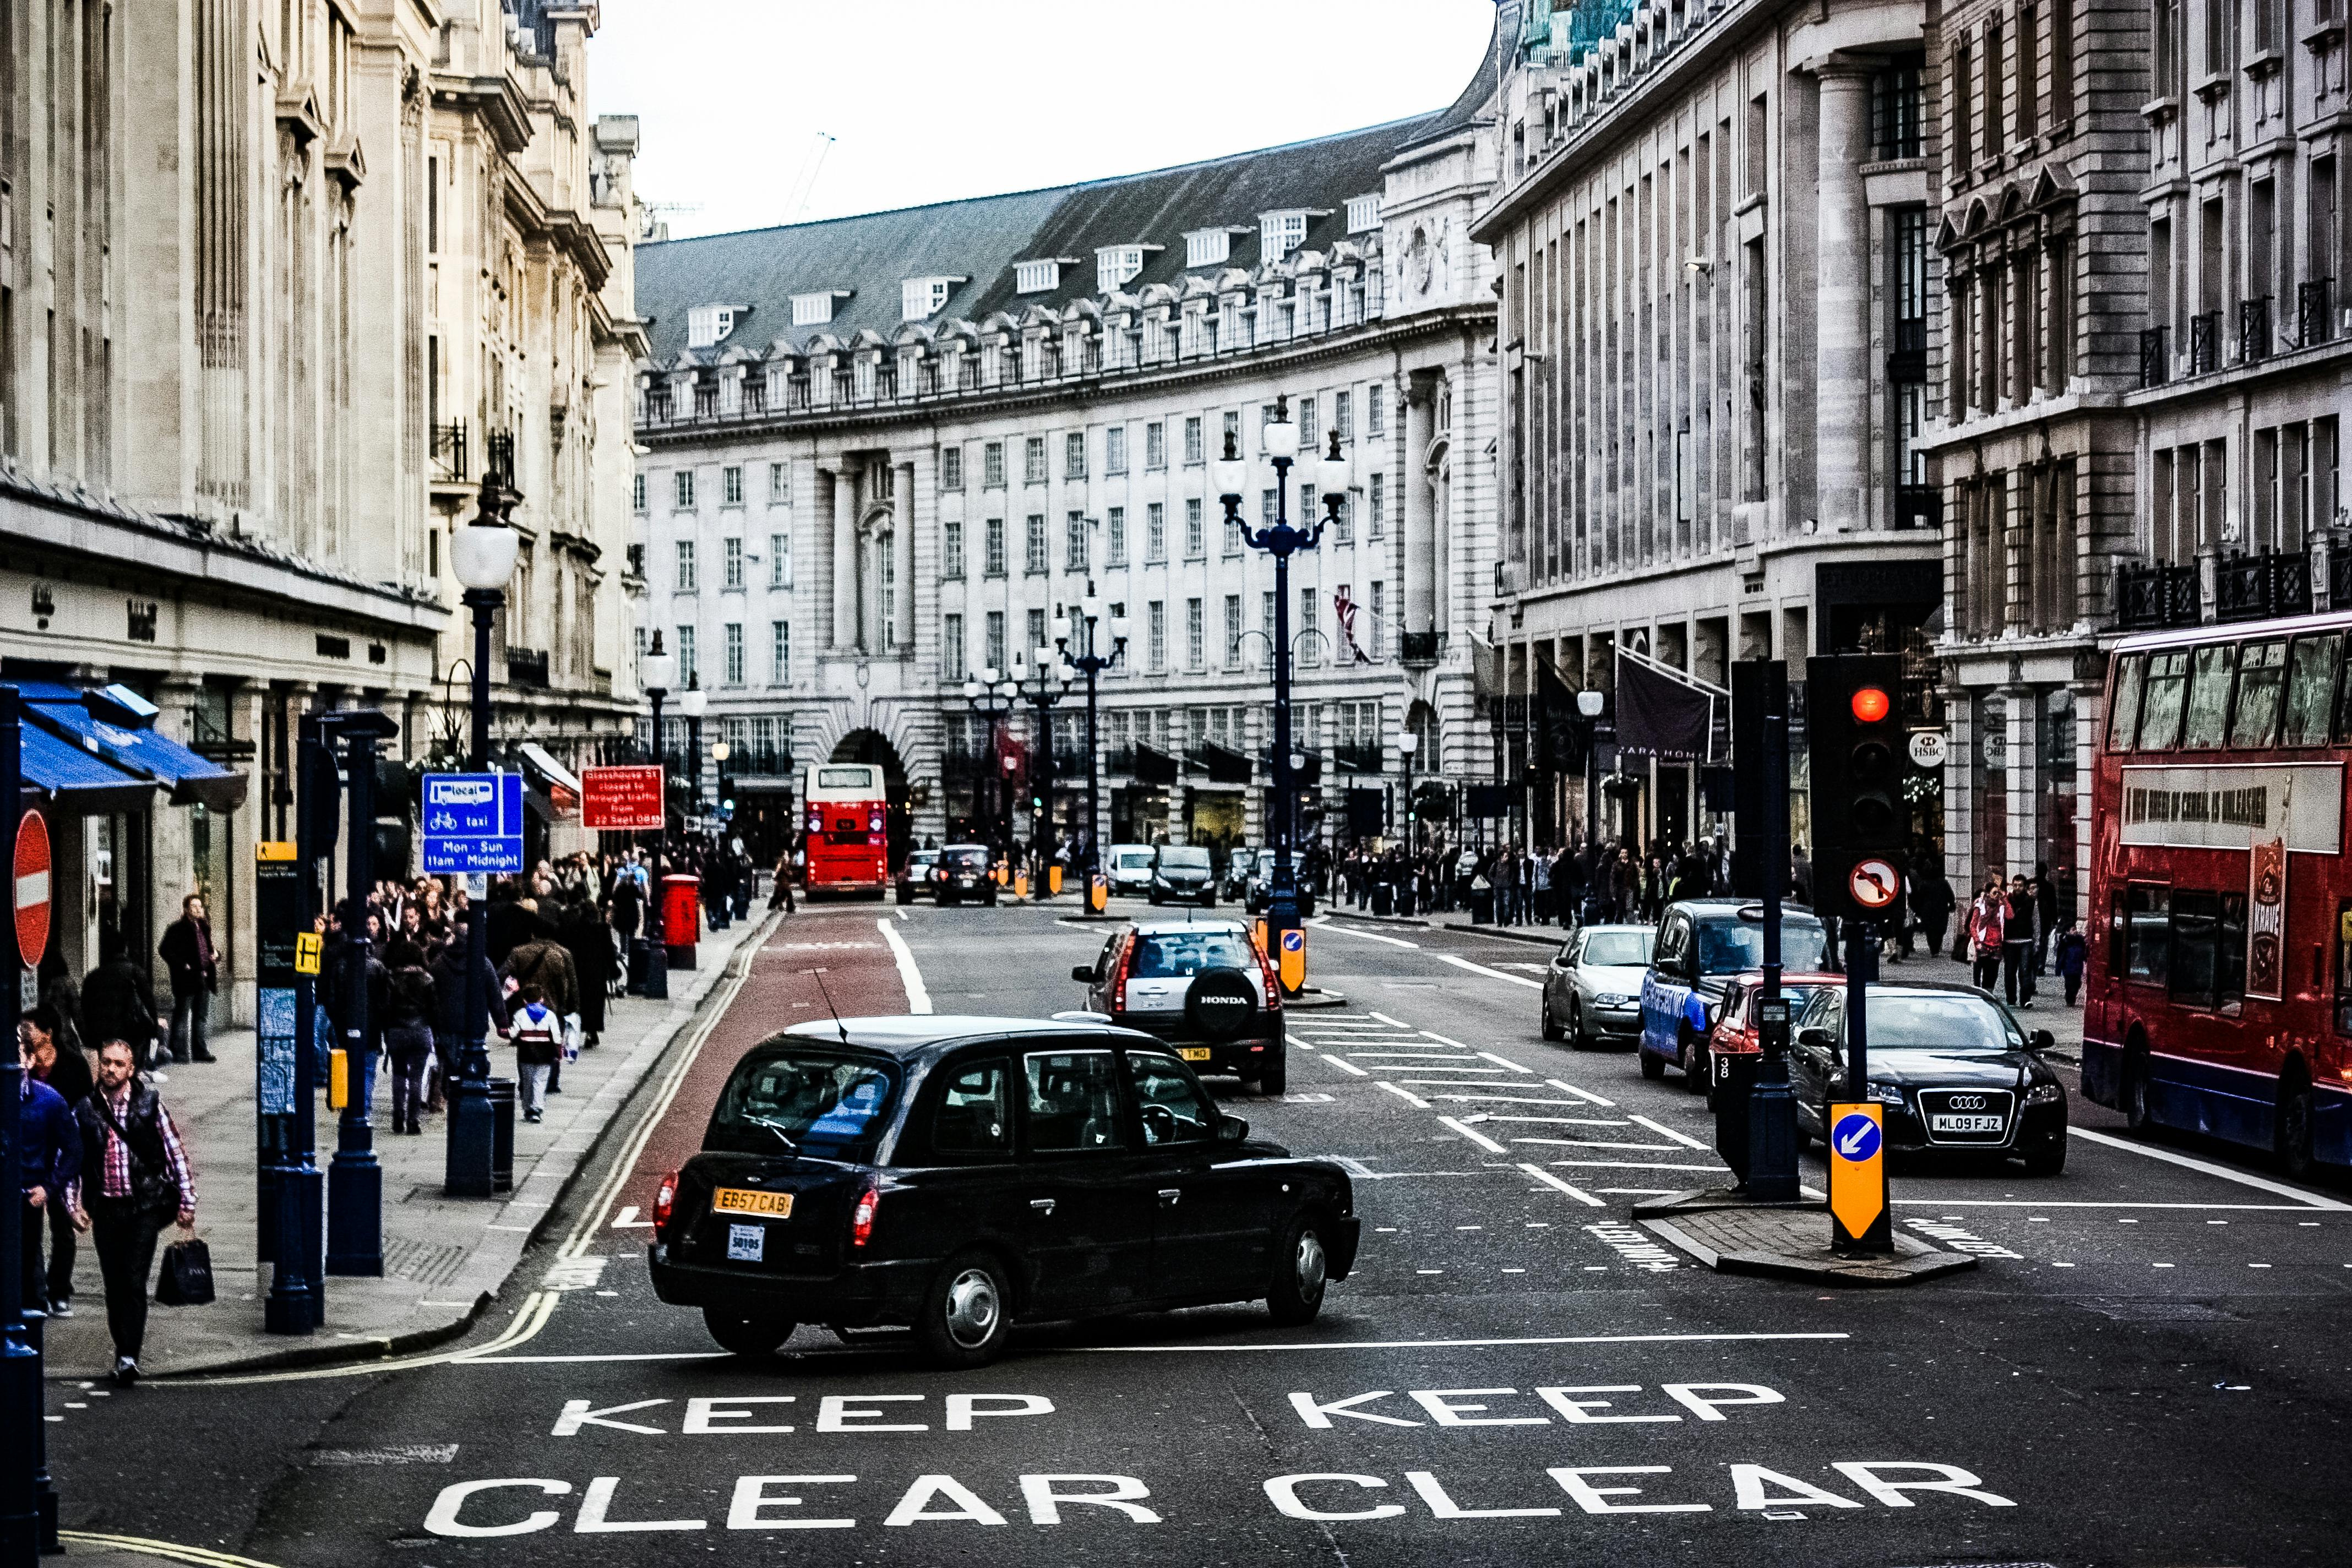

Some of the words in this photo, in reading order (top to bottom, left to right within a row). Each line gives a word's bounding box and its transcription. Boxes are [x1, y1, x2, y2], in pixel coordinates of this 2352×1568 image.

[1914, 746, 1944, 758] HSBC
[452, 785, 477, 796] local
[598, 781, 631, 791] closed
[634, 782, 644, 791] to
[586, 792, 625, 804] through
[627, 792, 658, 802] traffic
[611, 803, 634, 813] from
[2148, 789, 2170, 823] BREED
[2170, 791, 2181, 822] OF
[2181, 791, 2209, 823] CEREAL
[2211, 791, 2220, 823] IS
[2222, 786, 2267, 828] UNLEASHED
[466, 815, 488, 827] taxi
[443, 841, 468, 853] Mon
[481, 840, 503, 853] Sun
[427, 855, 455, 867] 11am
[467, 854, 518, 868] Midnight
[2253, 901, 2280, 937] KRAVE
[299, 938, 319, 968] H
[1201, 996, 1248, 1004] HONDA
[1939, 1118, 1972, 1130] ML09
[1974, 1118, 1999, 1130] FJZ
[721, 1191, 756, 1210] EB57
[759, 1195, 786, 1212] CAB
[1287, 1382, 1787, 1429] KEEP
[551, 1393, 1057, 1437] KEEP
[1262, 1460, 2018, 1521] CLEAR
[422, 1473, 1163, 1538] CLEAR
